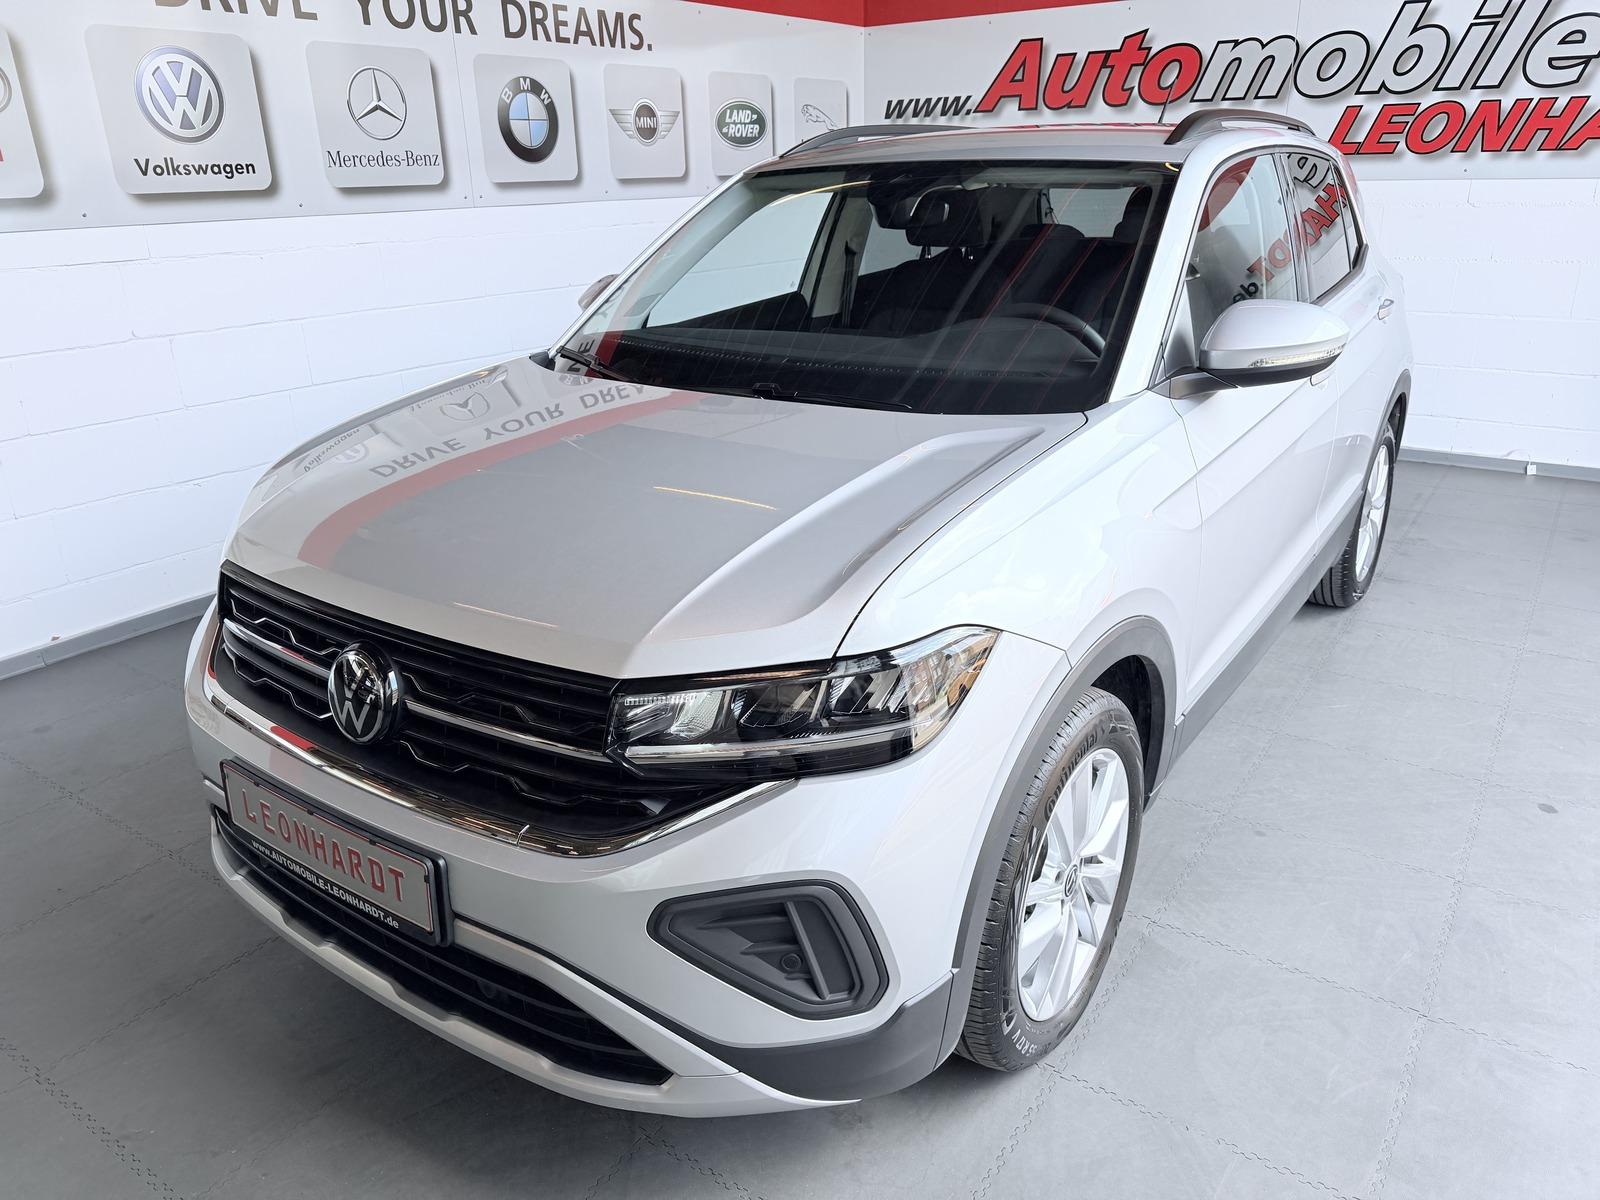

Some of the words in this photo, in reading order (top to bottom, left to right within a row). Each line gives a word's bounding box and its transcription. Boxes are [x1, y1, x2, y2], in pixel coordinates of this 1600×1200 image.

[501, 0, 652, 51] DREAMS.
[501, 77, 552, 105] BMW
[635, 116, 657, 129] MINI
[725, 109, 751, 123] LAND
[728, 124, 760, 137] ROVER
[133, 157, 257, 180] Volkswagen
[327, 150, 441, 168] Mercedes-Benz
[241, 788, 405, 902] LEONHARDT
[251, 839, 400, 929] www.AUTOMOBILE-LEONHARDT.de
